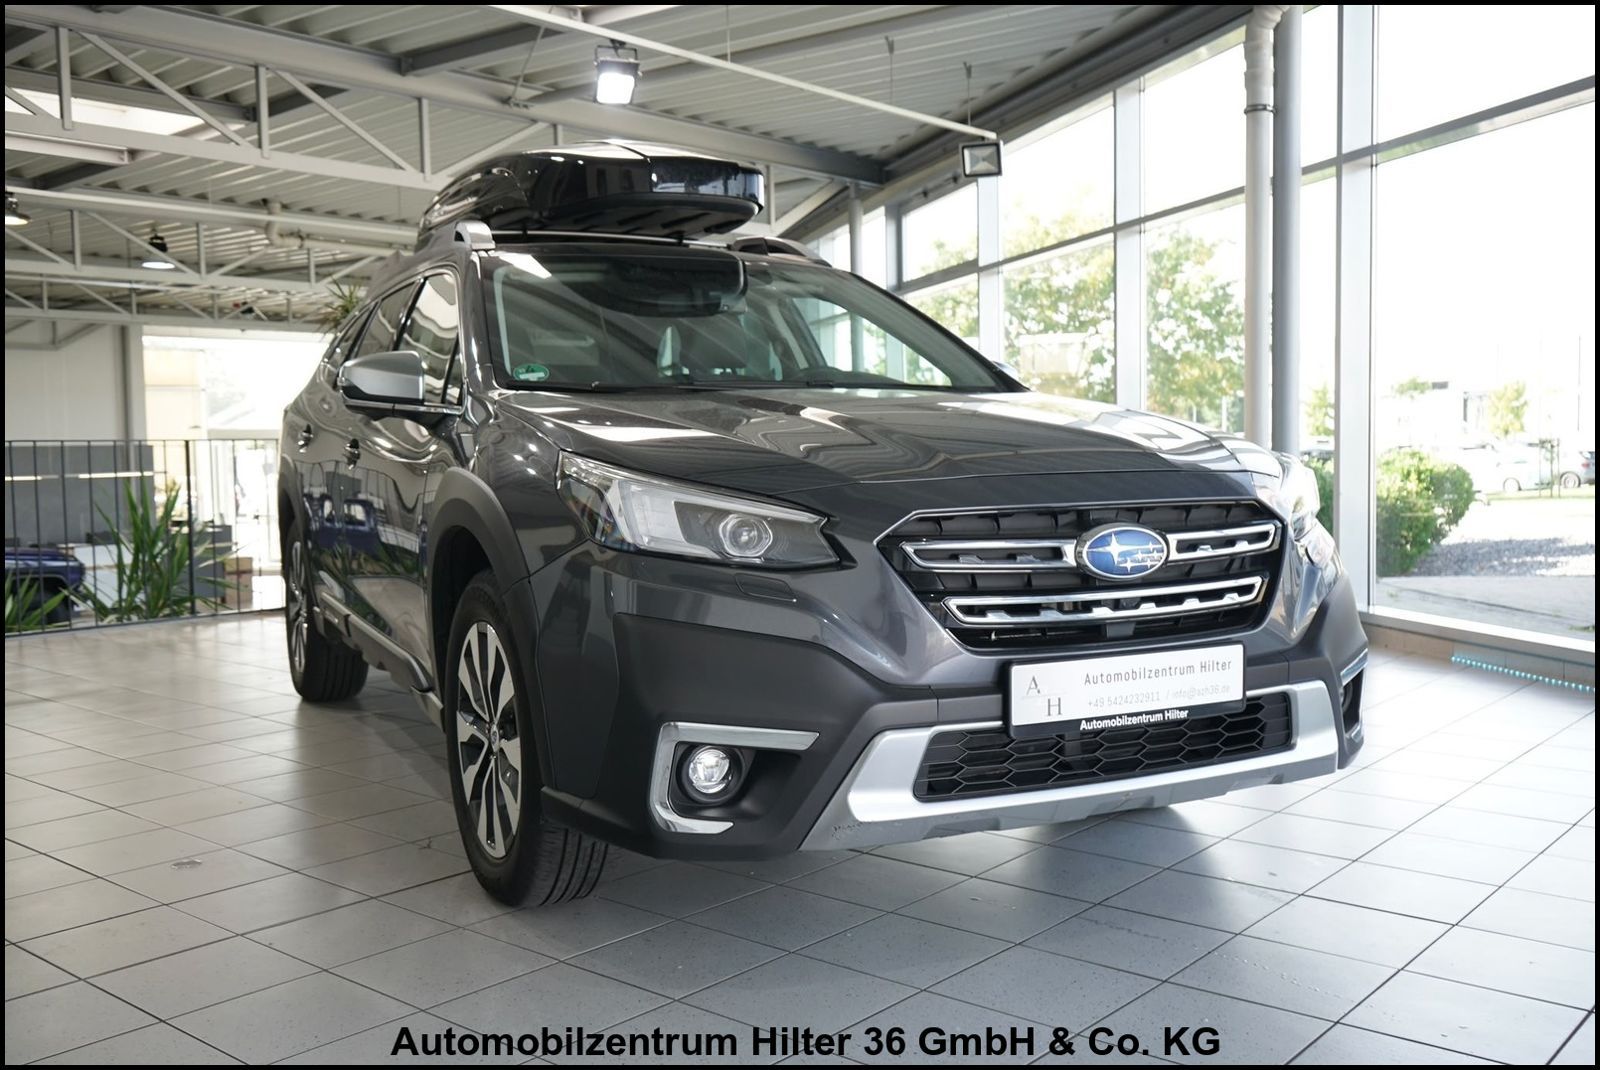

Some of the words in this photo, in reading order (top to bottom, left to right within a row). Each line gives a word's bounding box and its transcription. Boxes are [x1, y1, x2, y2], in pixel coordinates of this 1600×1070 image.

[1084, 664, 1195, 685] Automobilzentrum
[1200, 659, 1232, 673] Hilter
[1046, 697, 1062, 716] H
[1088, 695, 1104, 707] +49
[1080, 712, 1163, 731] Automobilzentrum
[1165, 709, 1189, 721] Hilter
